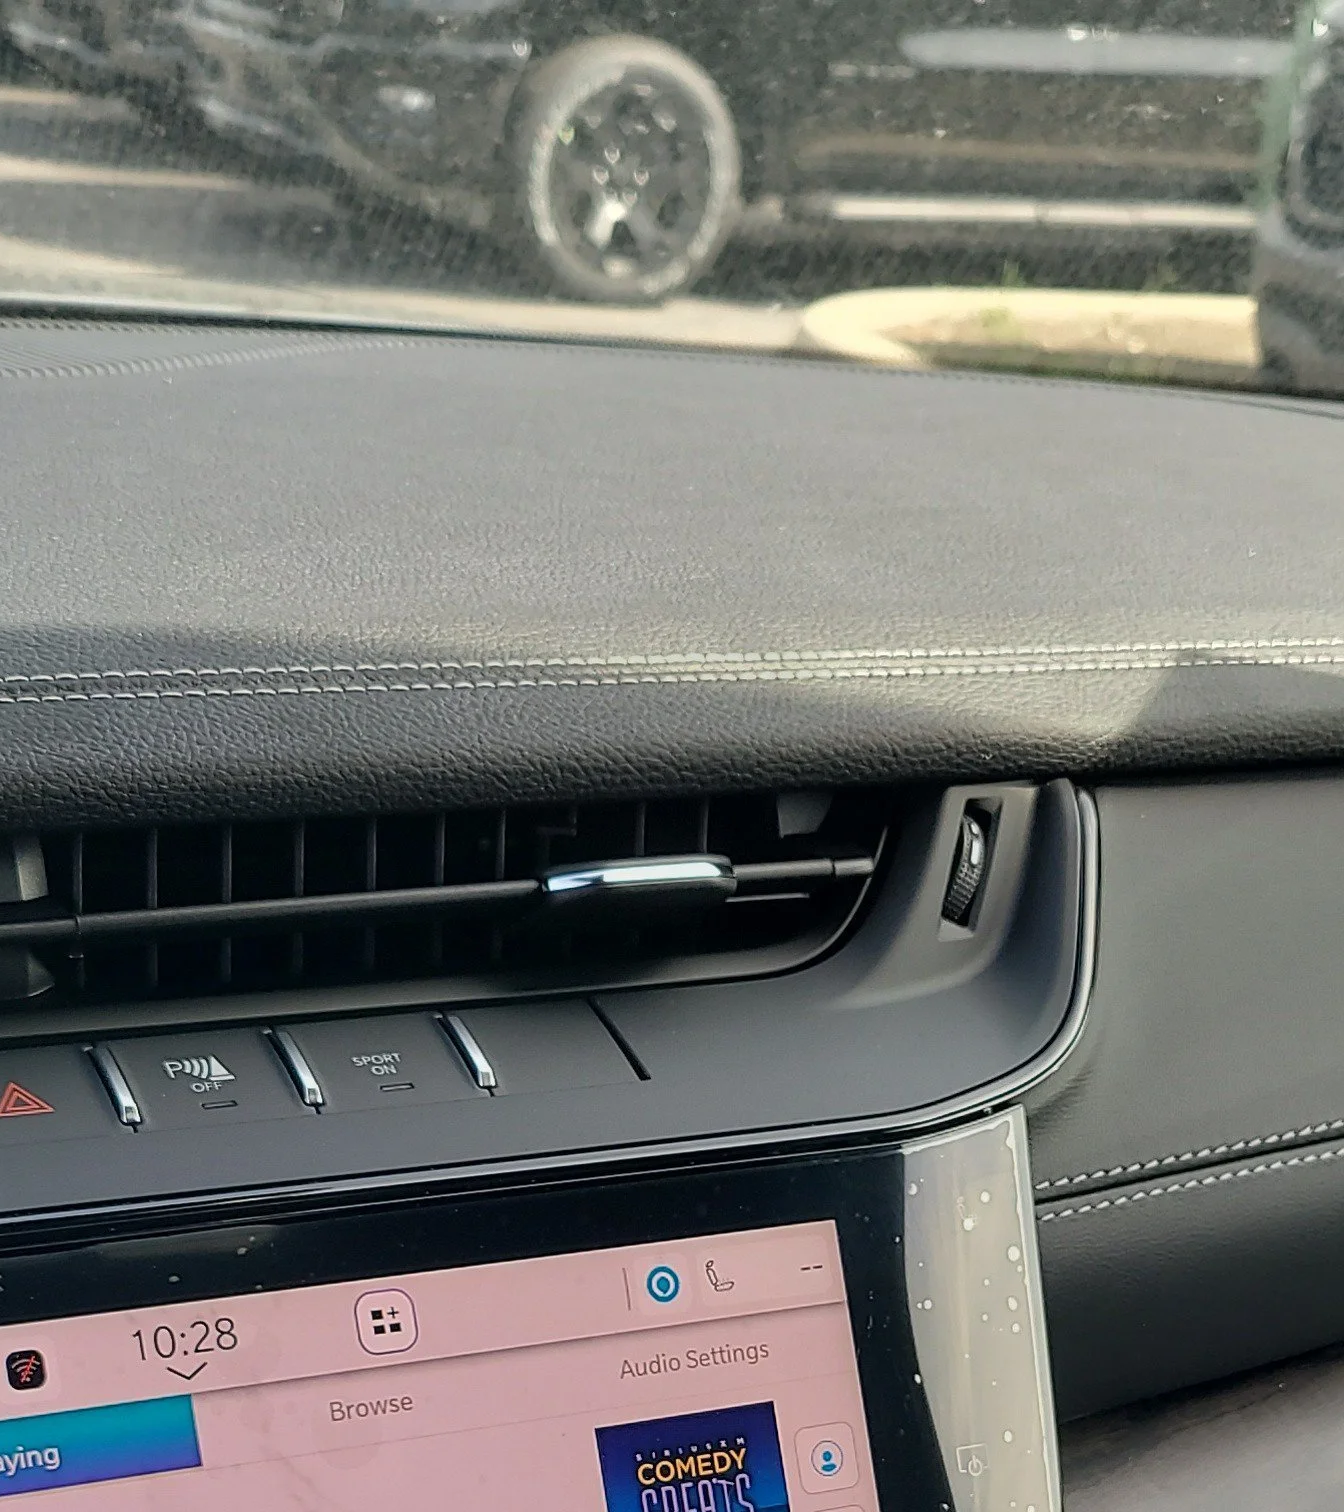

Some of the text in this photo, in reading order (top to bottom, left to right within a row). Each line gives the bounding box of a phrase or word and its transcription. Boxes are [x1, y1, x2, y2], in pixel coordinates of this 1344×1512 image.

[351, 1052, 402, 1067] SPORT
[371, 1064, 397, 1076] ON
[190, 1081, 223, 1093] OFF
[131, 1318, 239, 1361] 10:28
[619, 1339, 770, 1379] Audio Settings
[329, 1392, 413, 1421] Browse
[637, 1447, 746, 1485] COMEDY
